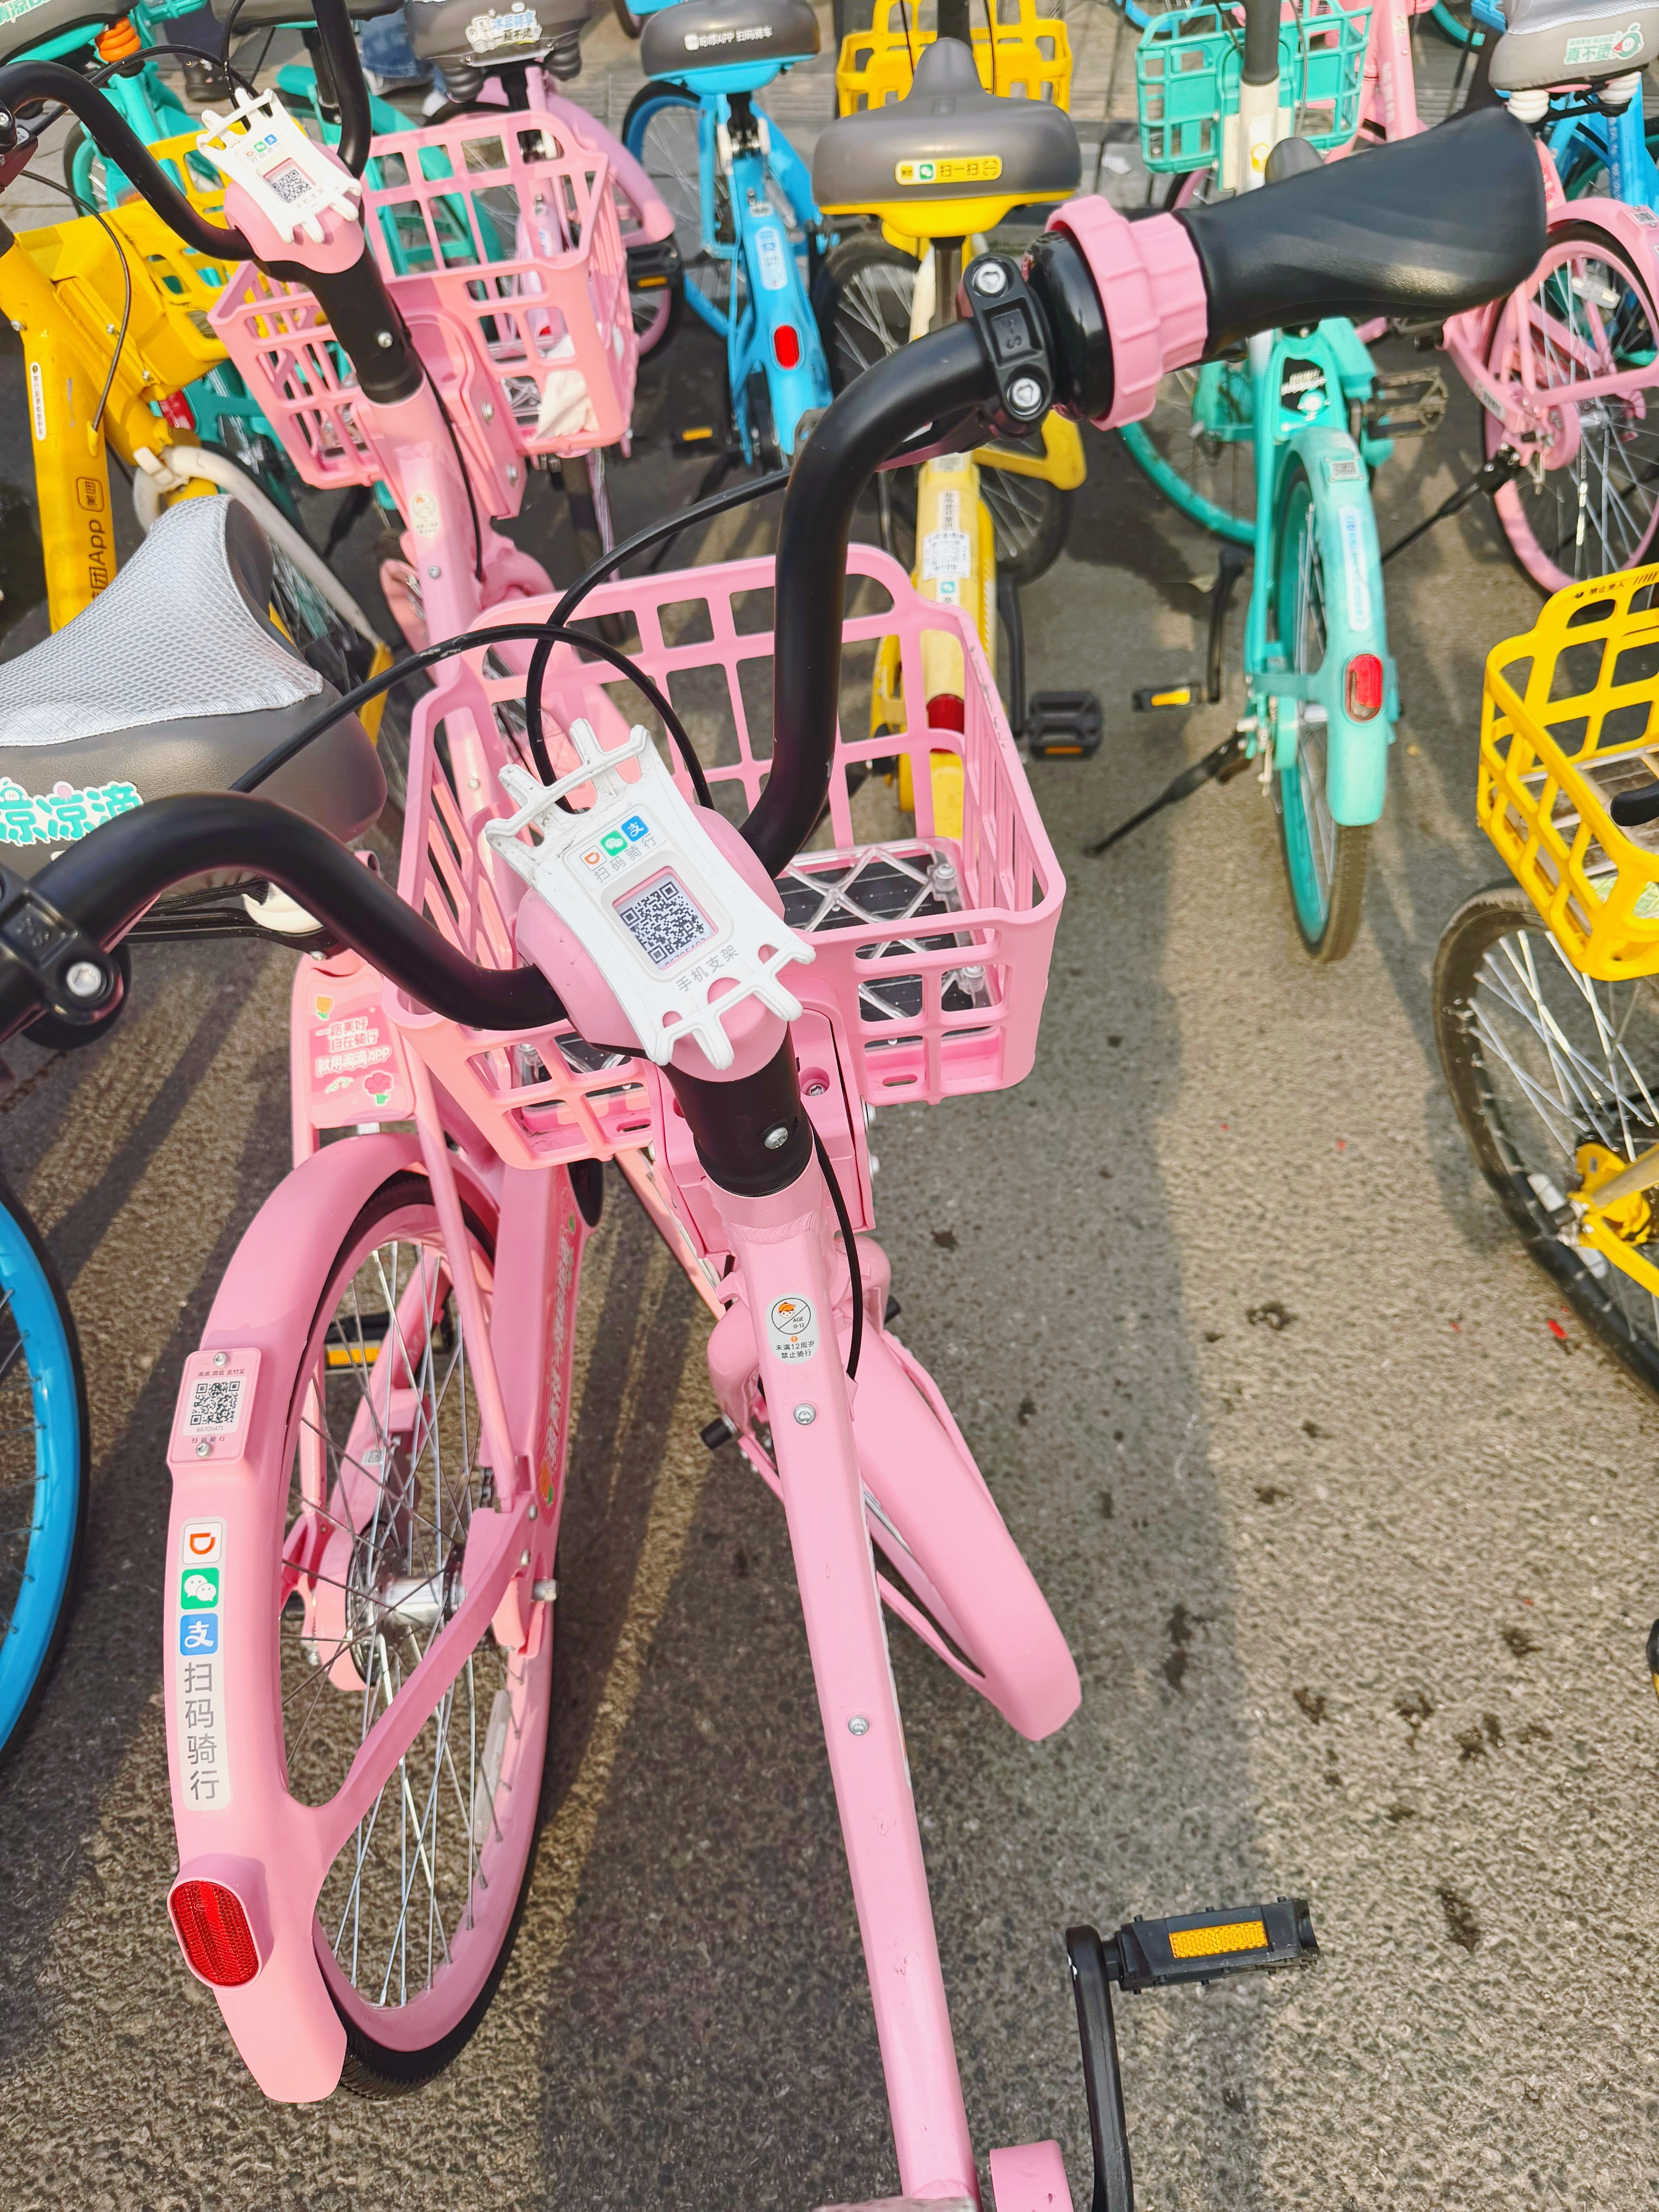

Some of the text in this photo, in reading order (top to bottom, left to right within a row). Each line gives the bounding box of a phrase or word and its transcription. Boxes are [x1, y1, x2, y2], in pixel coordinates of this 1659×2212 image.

[89, 520, 109, 599] 团App
[594, 833, 656, 883] 扫码骑行
[676, 945, 739, 992] 手机支架
[317, 1018, 367, 1036] 一路美好
[332, 1030, 378, 1051] 自在骑行
[775, 1340, 814, 1351] 未满12周岁
[781, 1349, 812, 1359] 禁止骑行
[184, 1662, 220, 1802] 扫码骑行
